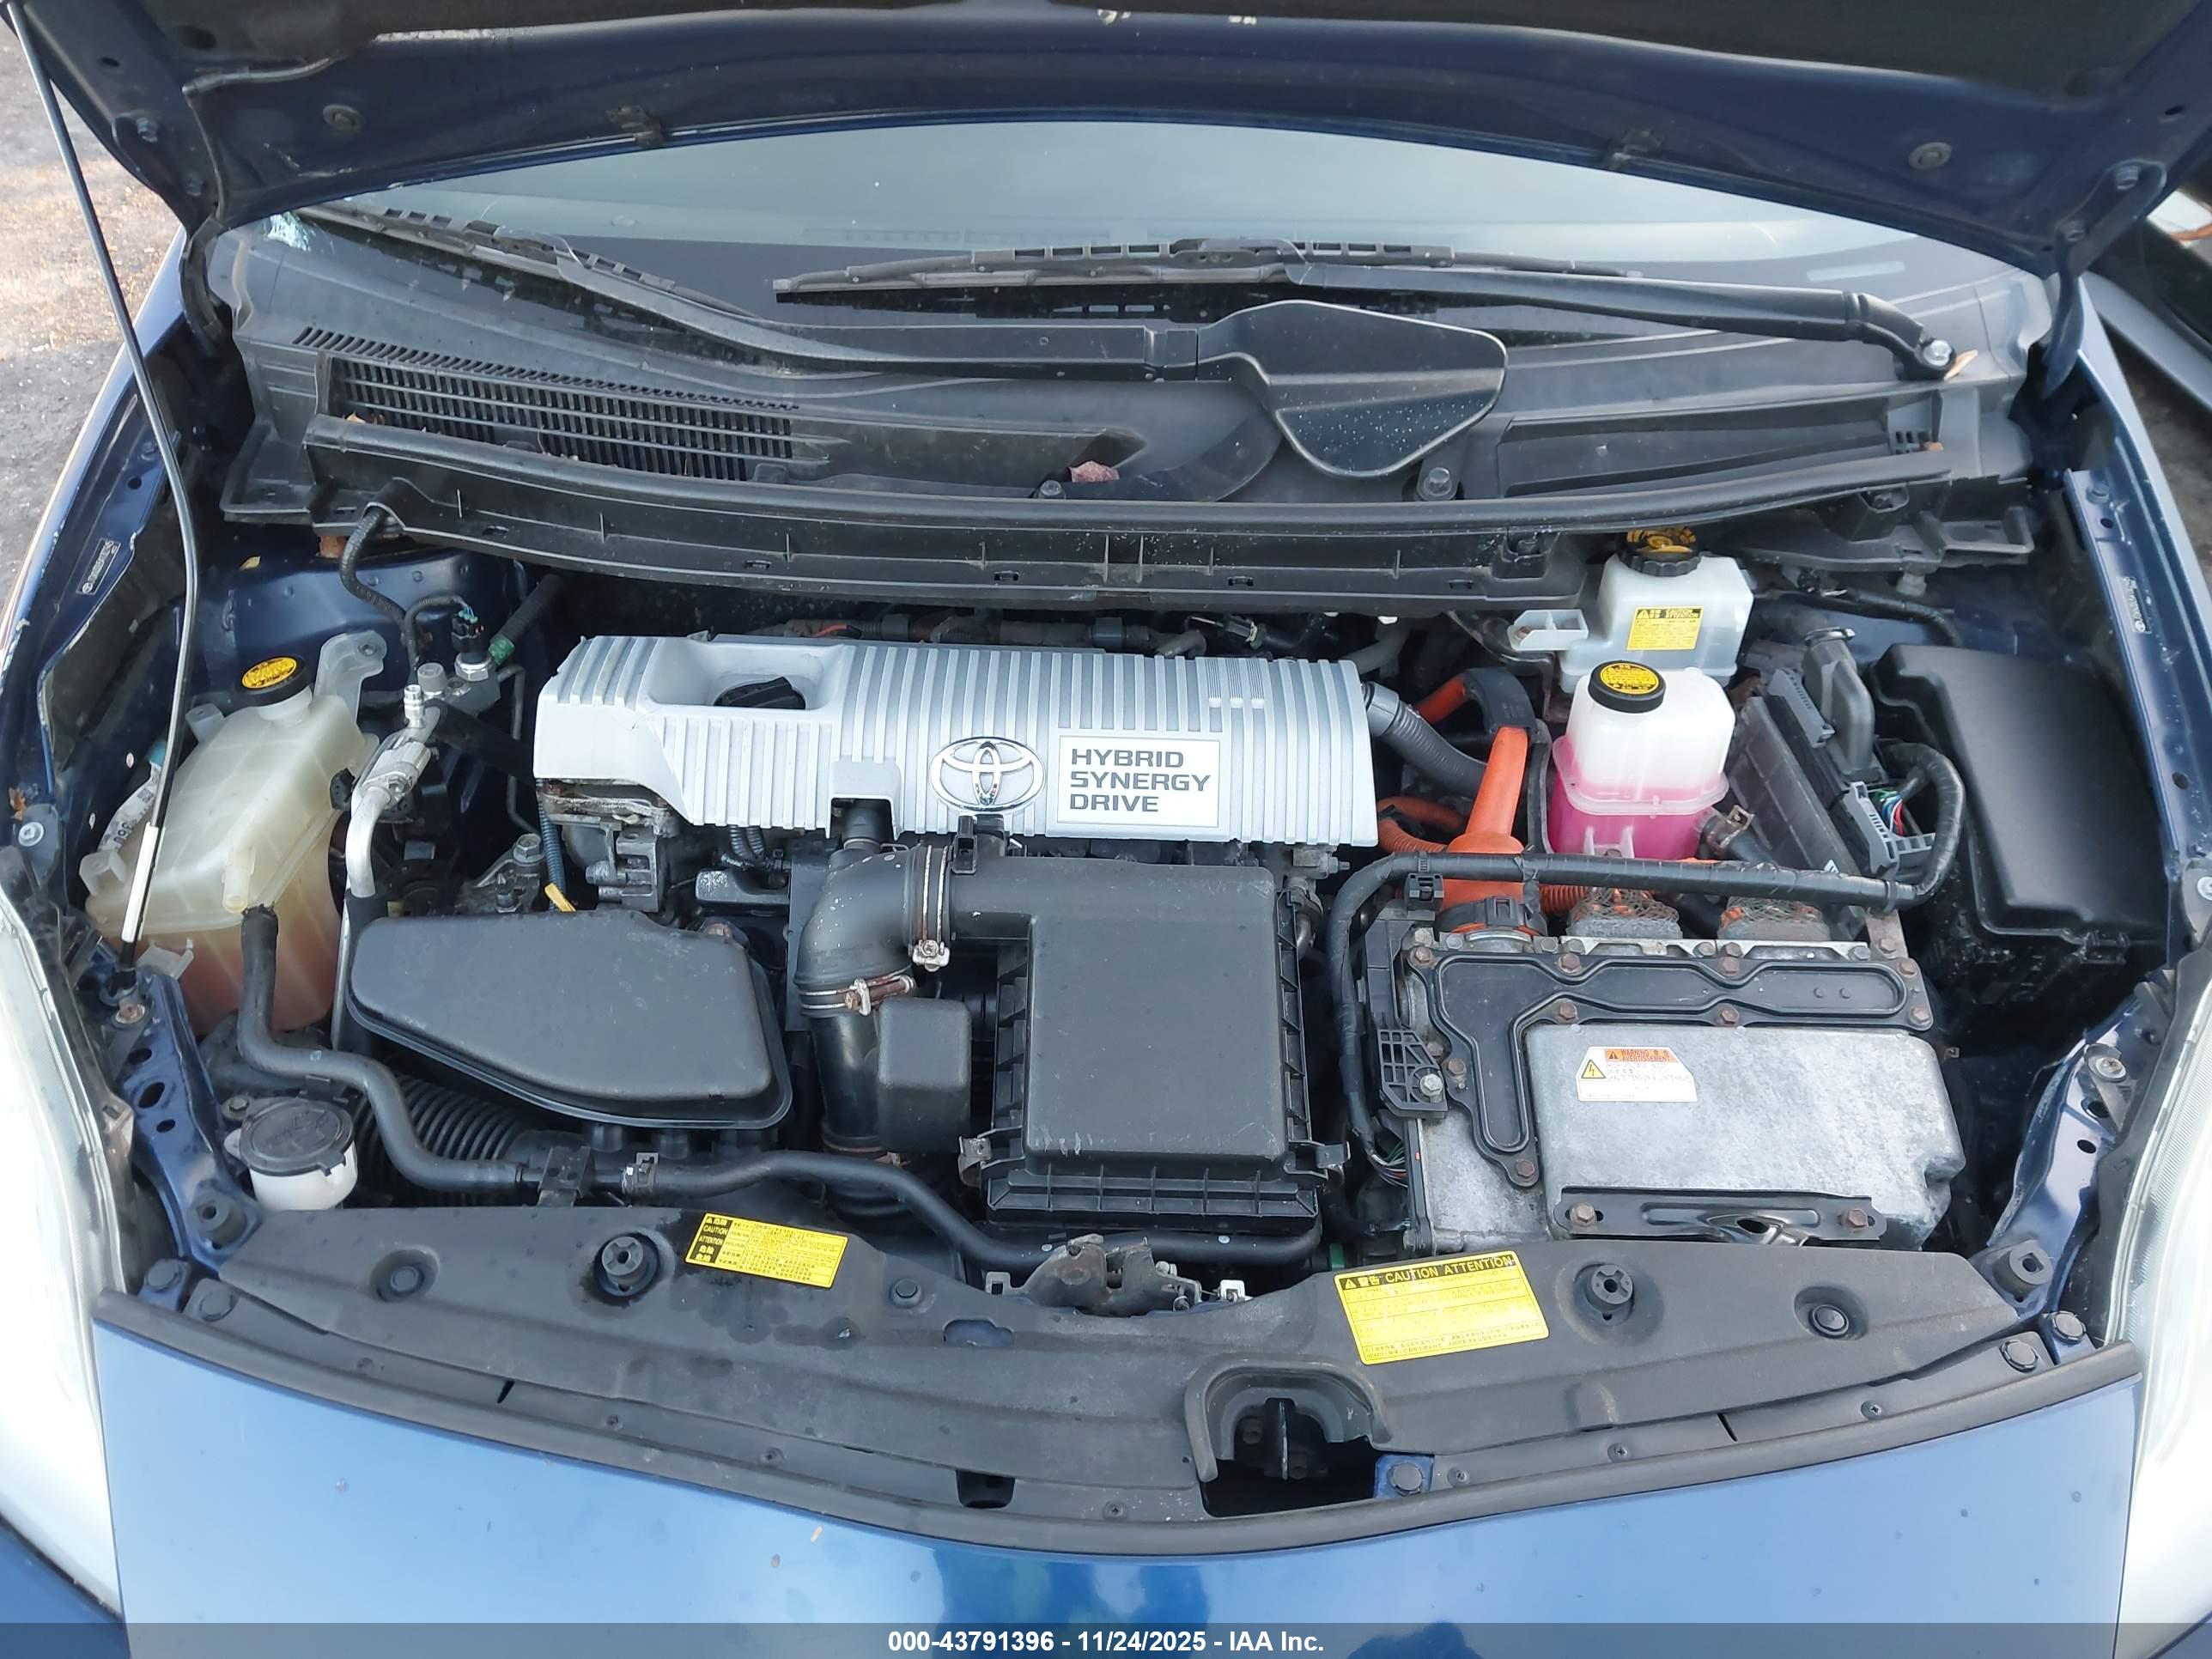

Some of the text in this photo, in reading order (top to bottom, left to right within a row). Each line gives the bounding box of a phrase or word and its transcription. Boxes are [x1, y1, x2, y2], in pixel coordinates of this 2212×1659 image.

[1072, 749, 1184, 769] HYBRID
[1071, 771, 1211, 792] SYNERGY
[1070, 793, 1159, 812] DRIVE
[703, 1224, 728, 1236] CAUTION
[698, 1235, 724, 1246] ATTENTION
[1385, 1267, 1438, 1285] CAUTION
[1444, 1255, 1514, 1276] ATTENTION
